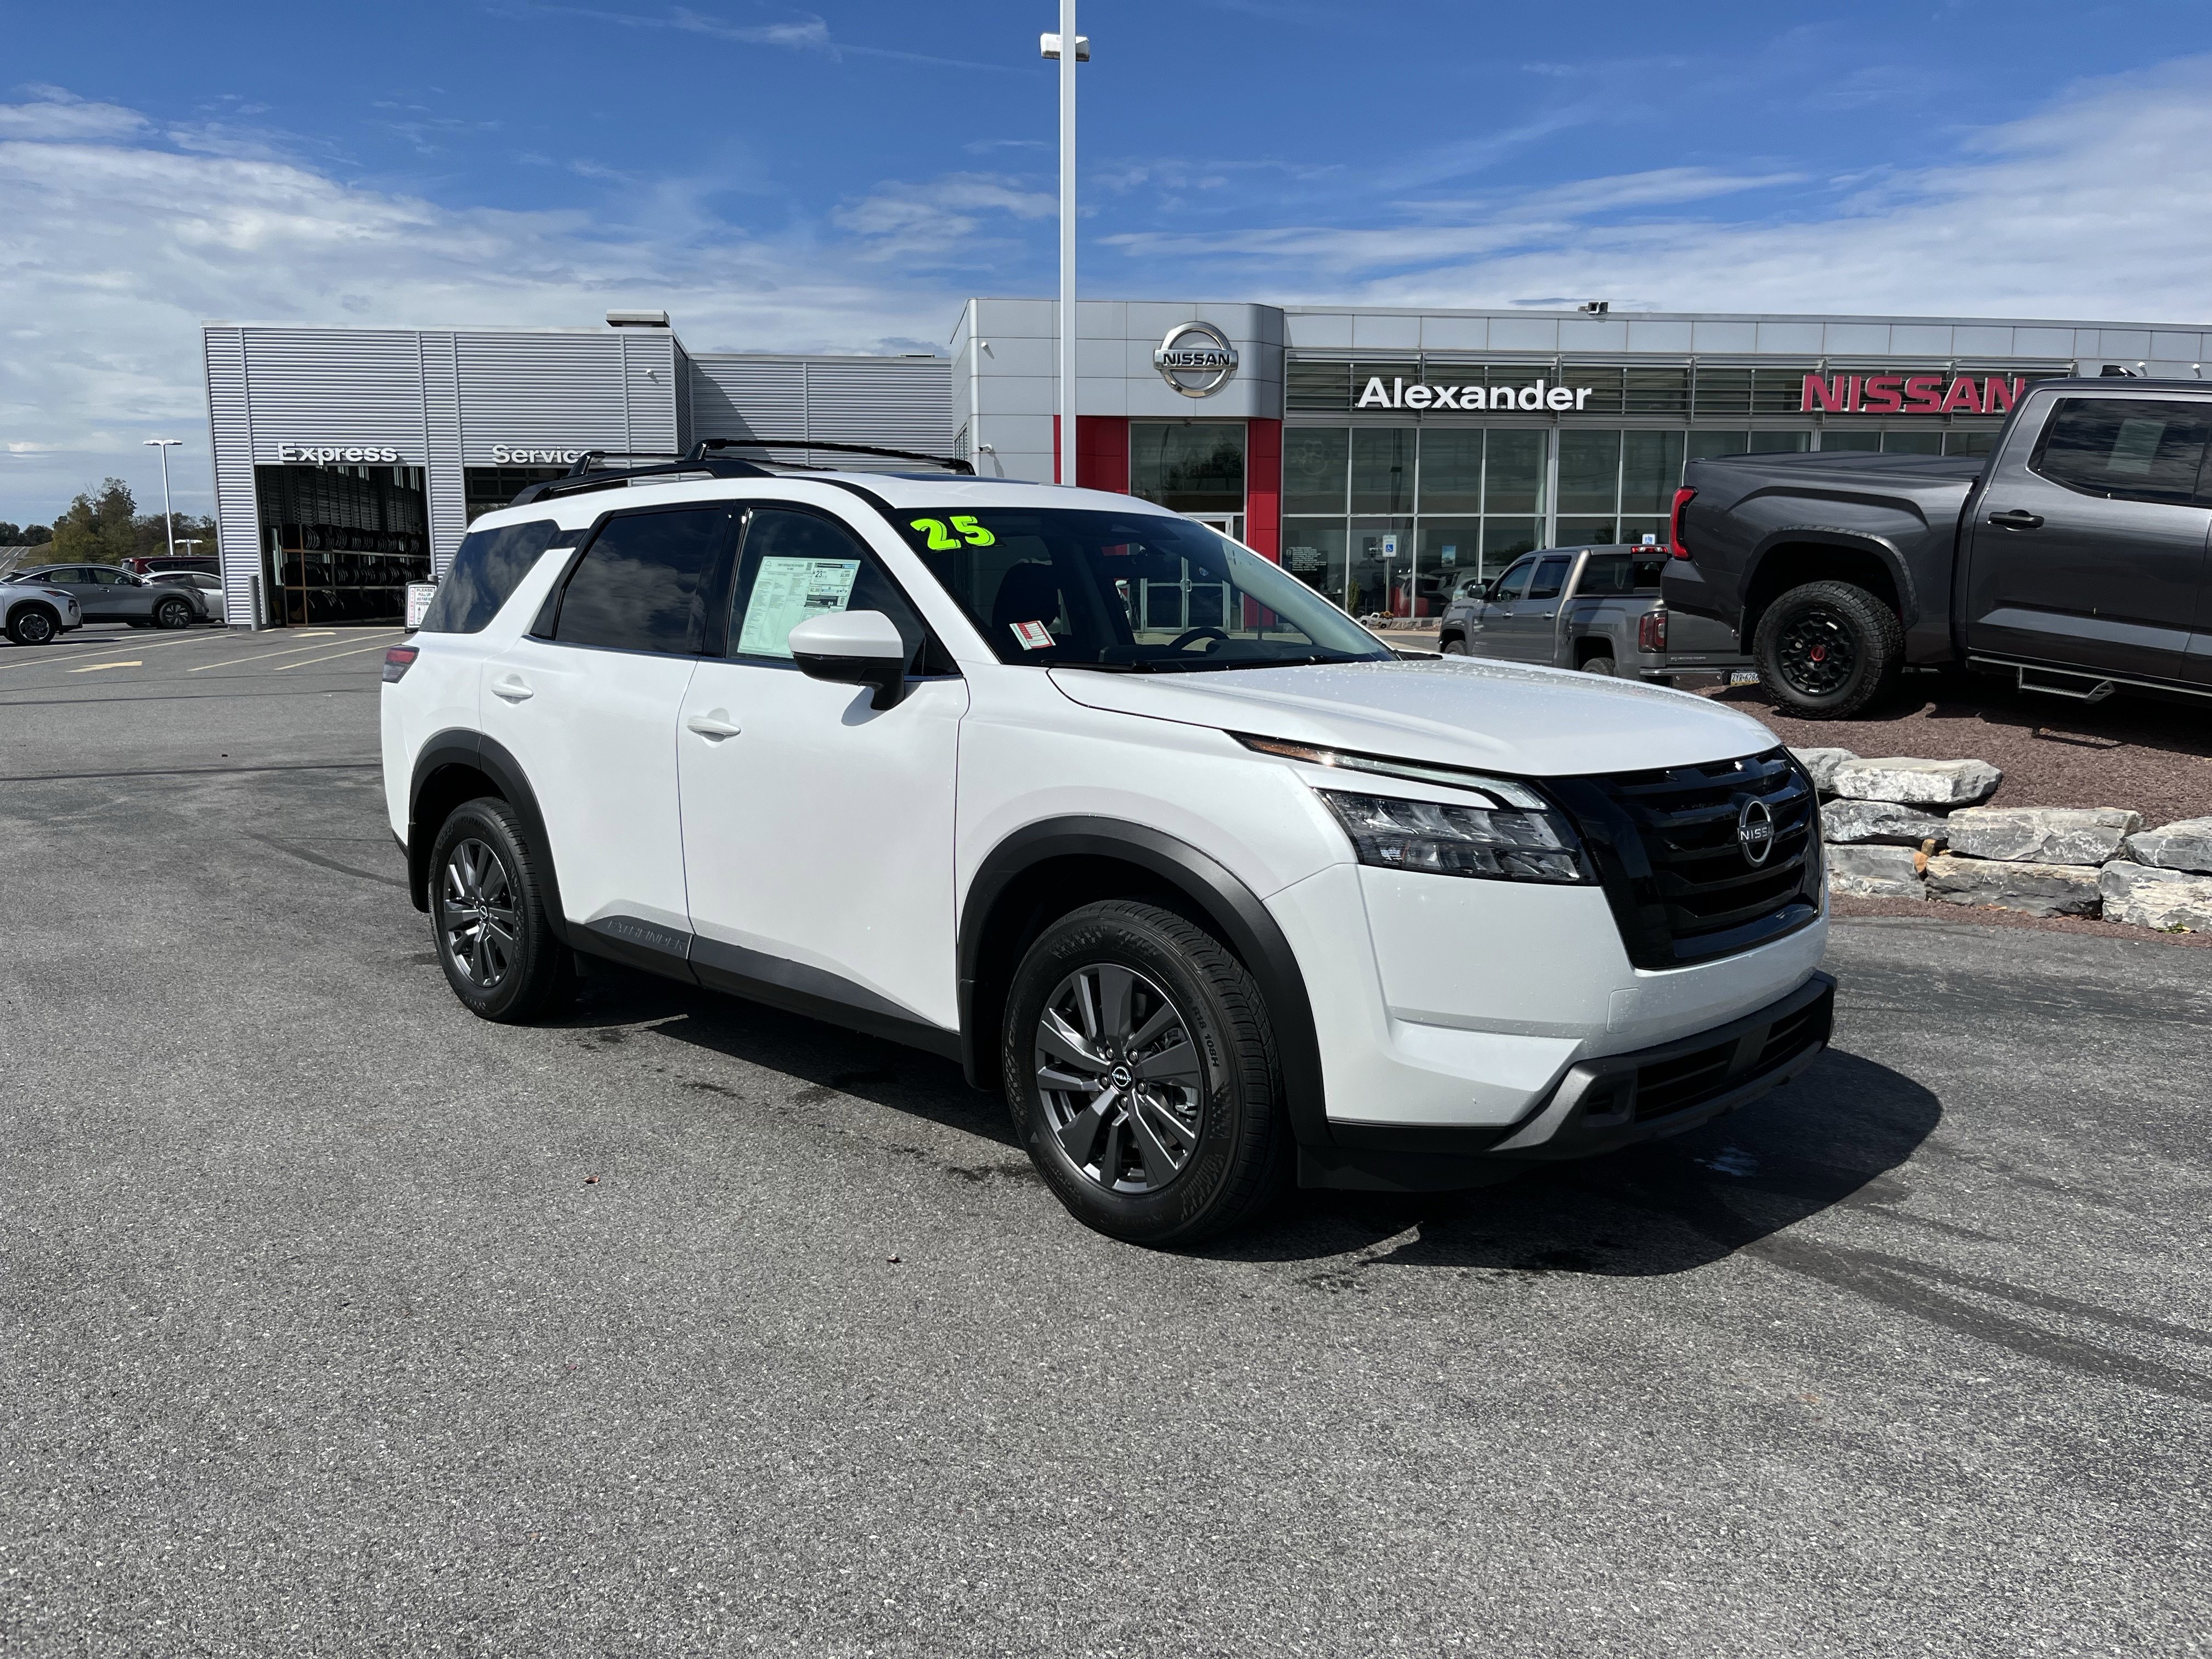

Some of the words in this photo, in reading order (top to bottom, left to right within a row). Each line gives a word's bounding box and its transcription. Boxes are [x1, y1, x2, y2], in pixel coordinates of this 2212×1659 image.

[1163, 353, 1230, 365] NISSAN
[1357, 377, 1592, 410] Alexander
[1801, 375, 2025, 413] NISSAN
[278, 442, 397, 465] Express
[492, 445, 592, 464] Servic
[910, 516, 995, 550] 25
